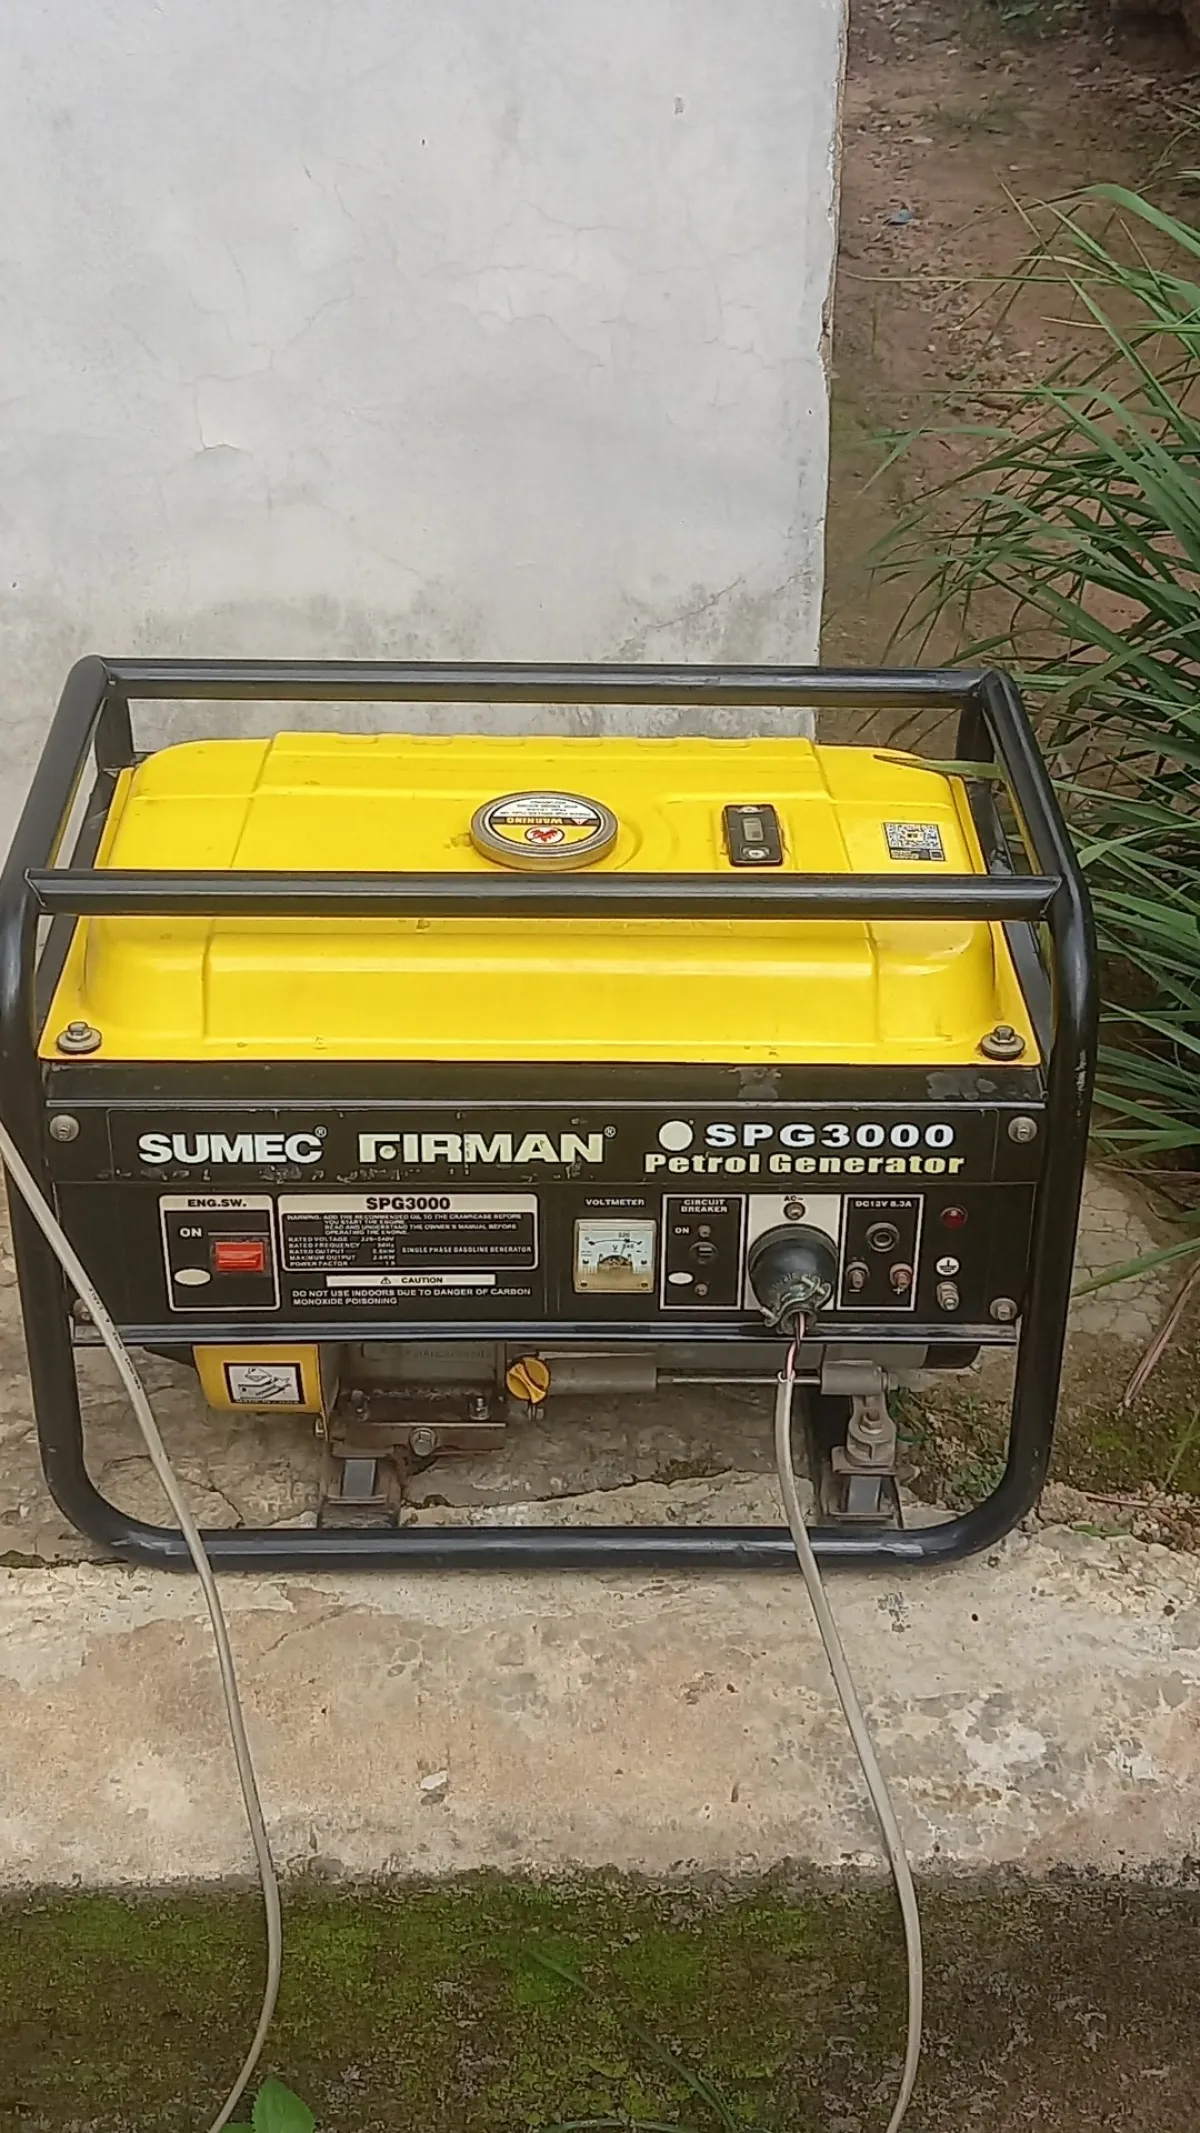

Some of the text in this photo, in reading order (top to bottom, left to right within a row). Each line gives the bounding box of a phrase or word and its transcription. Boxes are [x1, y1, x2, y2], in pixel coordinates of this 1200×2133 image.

[705, 1123, 955, 1148] SPG3000
[644, 1153, 965, 1174] Petrol Generator
[187, 1199, 247, 1208] ENG.SW.
[366, 1197, 451, 1210] SPG3000
[179, 1227, 202, 1237] ON
[674, 1227, 690, 1235] ON
[418, 1288, 432, 1296] TO
[433, 1288, 473, 1296] DANGER
[476, 1288, 489, 1296] OF
[490, 1288, 531, 1296] CARBON
